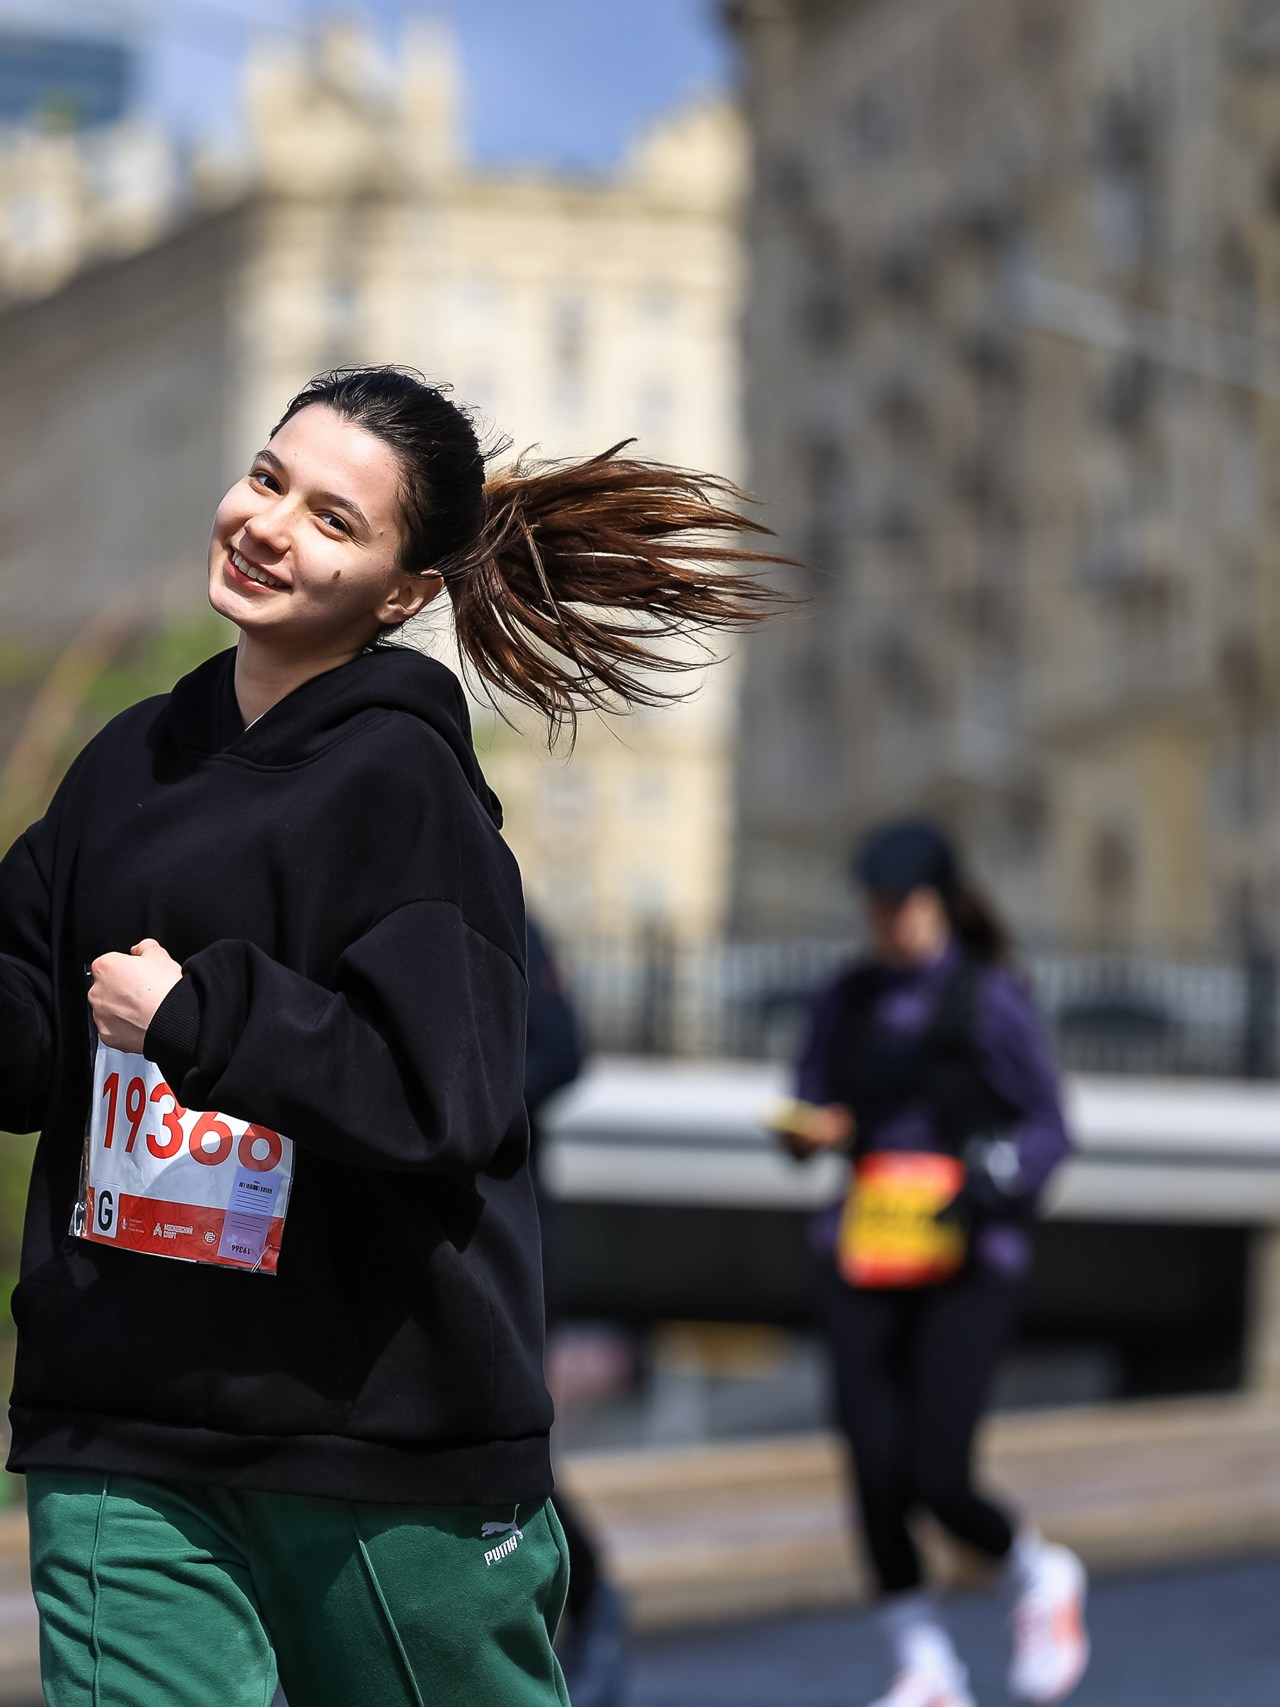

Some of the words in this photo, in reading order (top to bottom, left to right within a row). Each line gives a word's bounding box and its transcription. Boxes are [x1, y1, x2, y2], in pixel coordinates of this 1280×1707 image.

[102, 1072, 283, 1172] 19366
[97, 1190, 114, 1231] G
[231, 1244, 251, 1255] 19366
[483, 1535, 518, 1566] PUMA
